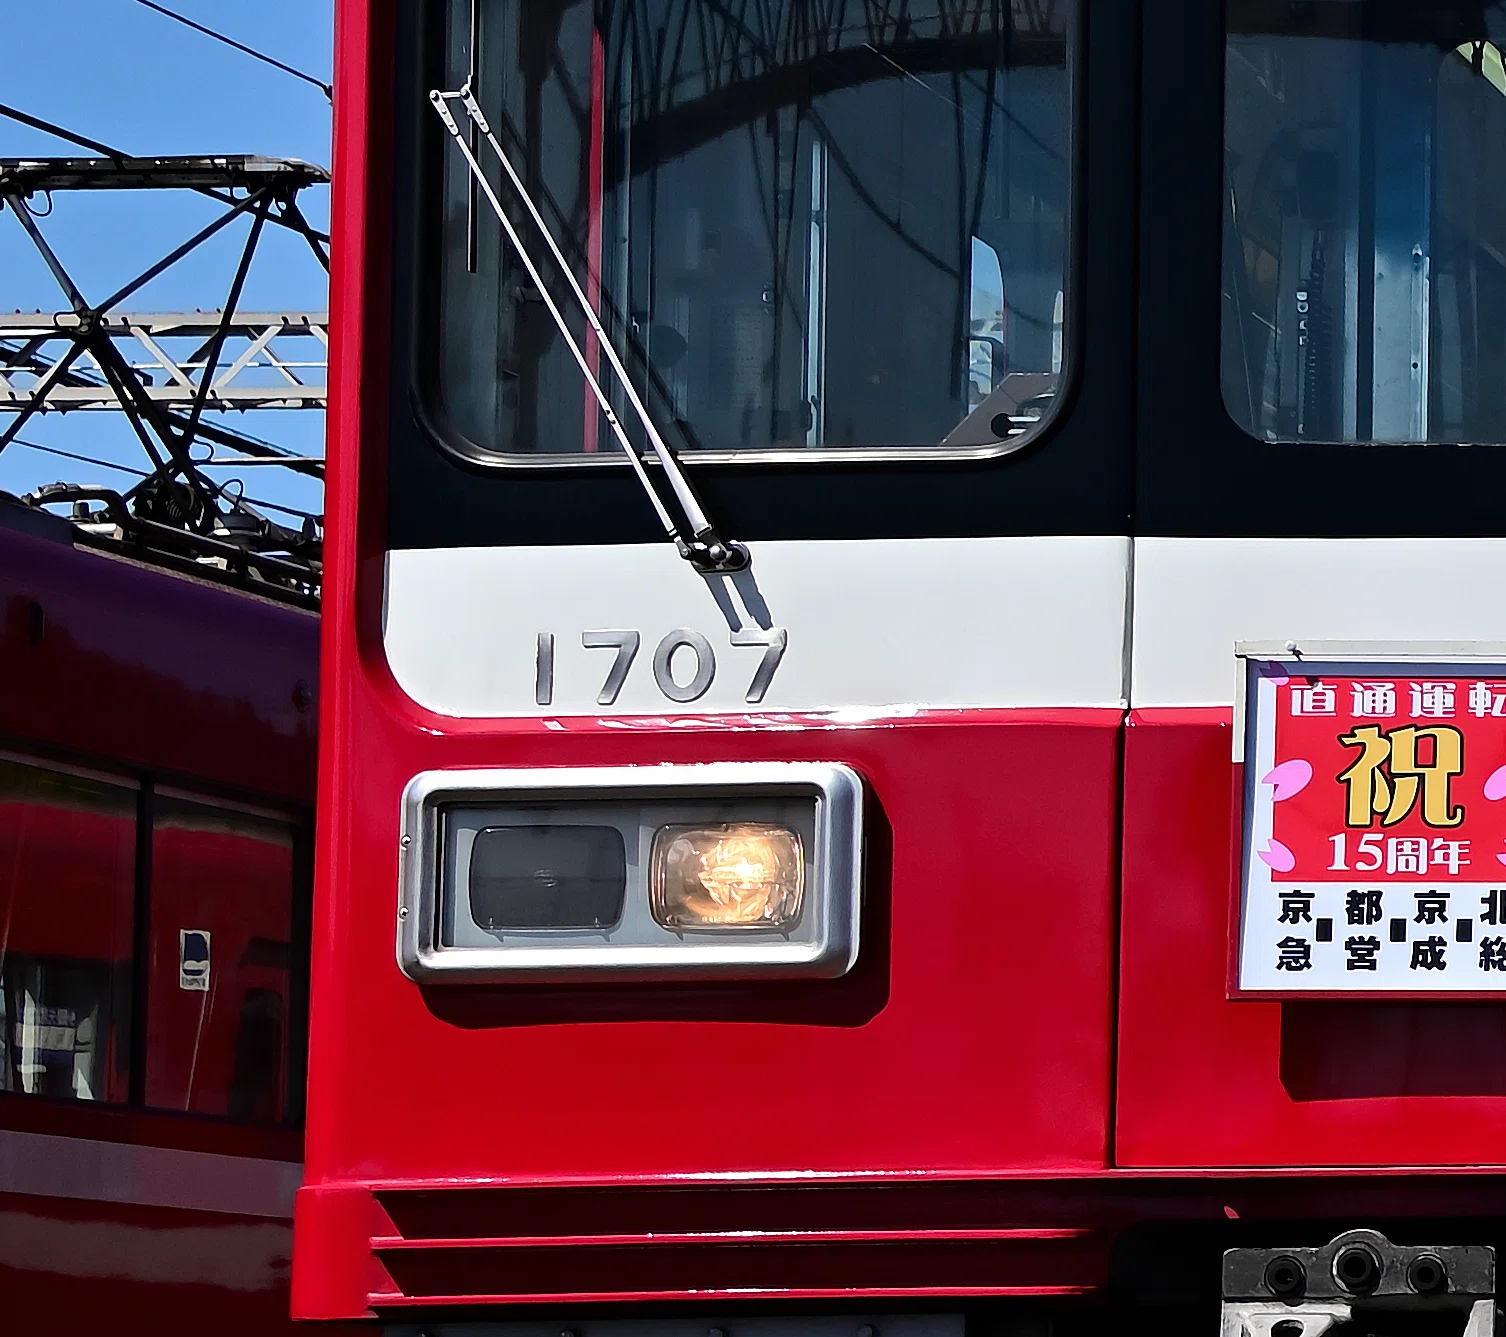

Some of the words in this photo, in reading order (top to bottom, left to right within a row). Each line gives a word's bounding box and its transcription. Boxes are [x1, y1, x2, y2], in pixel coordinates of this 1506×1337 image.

[535, 628, 788, 705] 1707
[1336, 724, 1465, 828] 祝
[1326, 833, 1471, 875] 15周年
